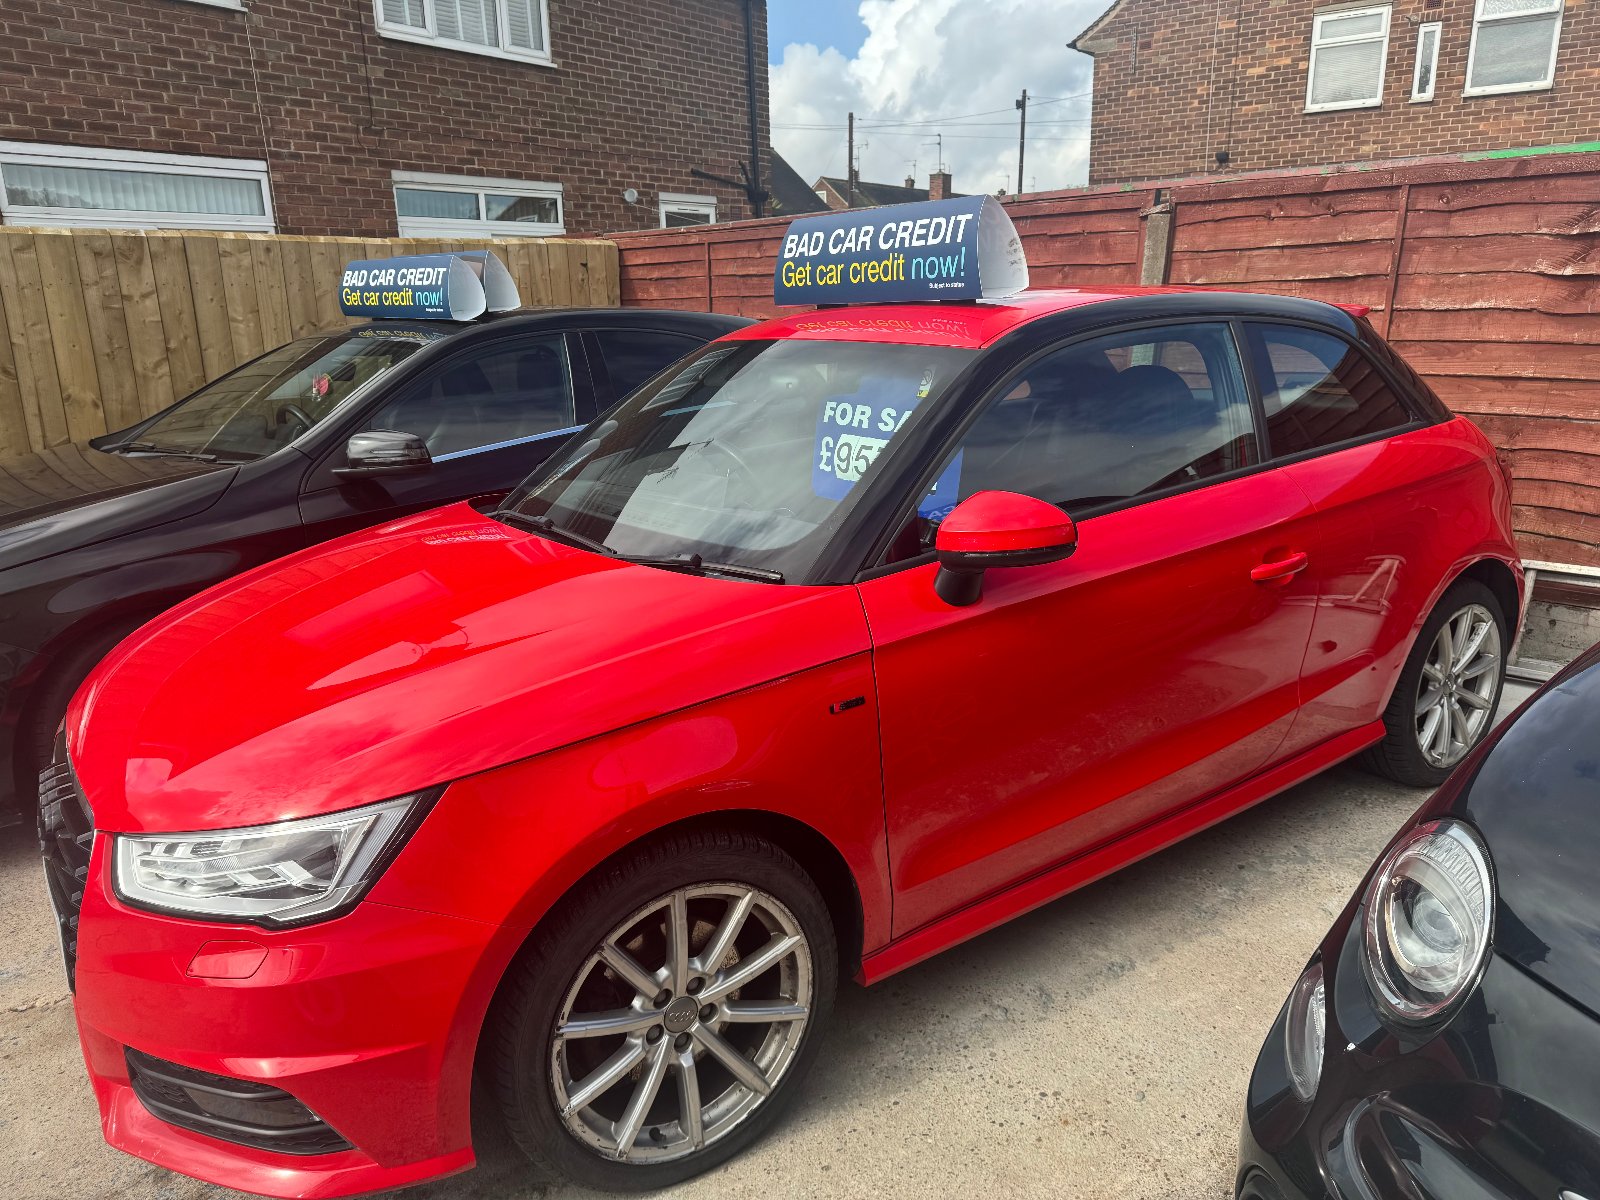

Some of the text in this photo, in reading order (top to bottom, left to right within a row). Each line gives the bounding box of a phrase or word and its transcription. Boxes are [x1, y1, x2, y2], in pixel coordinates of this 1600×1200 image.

[783, 213, 973, 259] BAD CAR CREDIT
[342, 267, 447, 287] BAD CAR CREDIT
[782, 246, 966, 288] Get car credit now!
[342, 287, 443, 306] Get car credit now!
[823, 401, 872, 429] FOR
